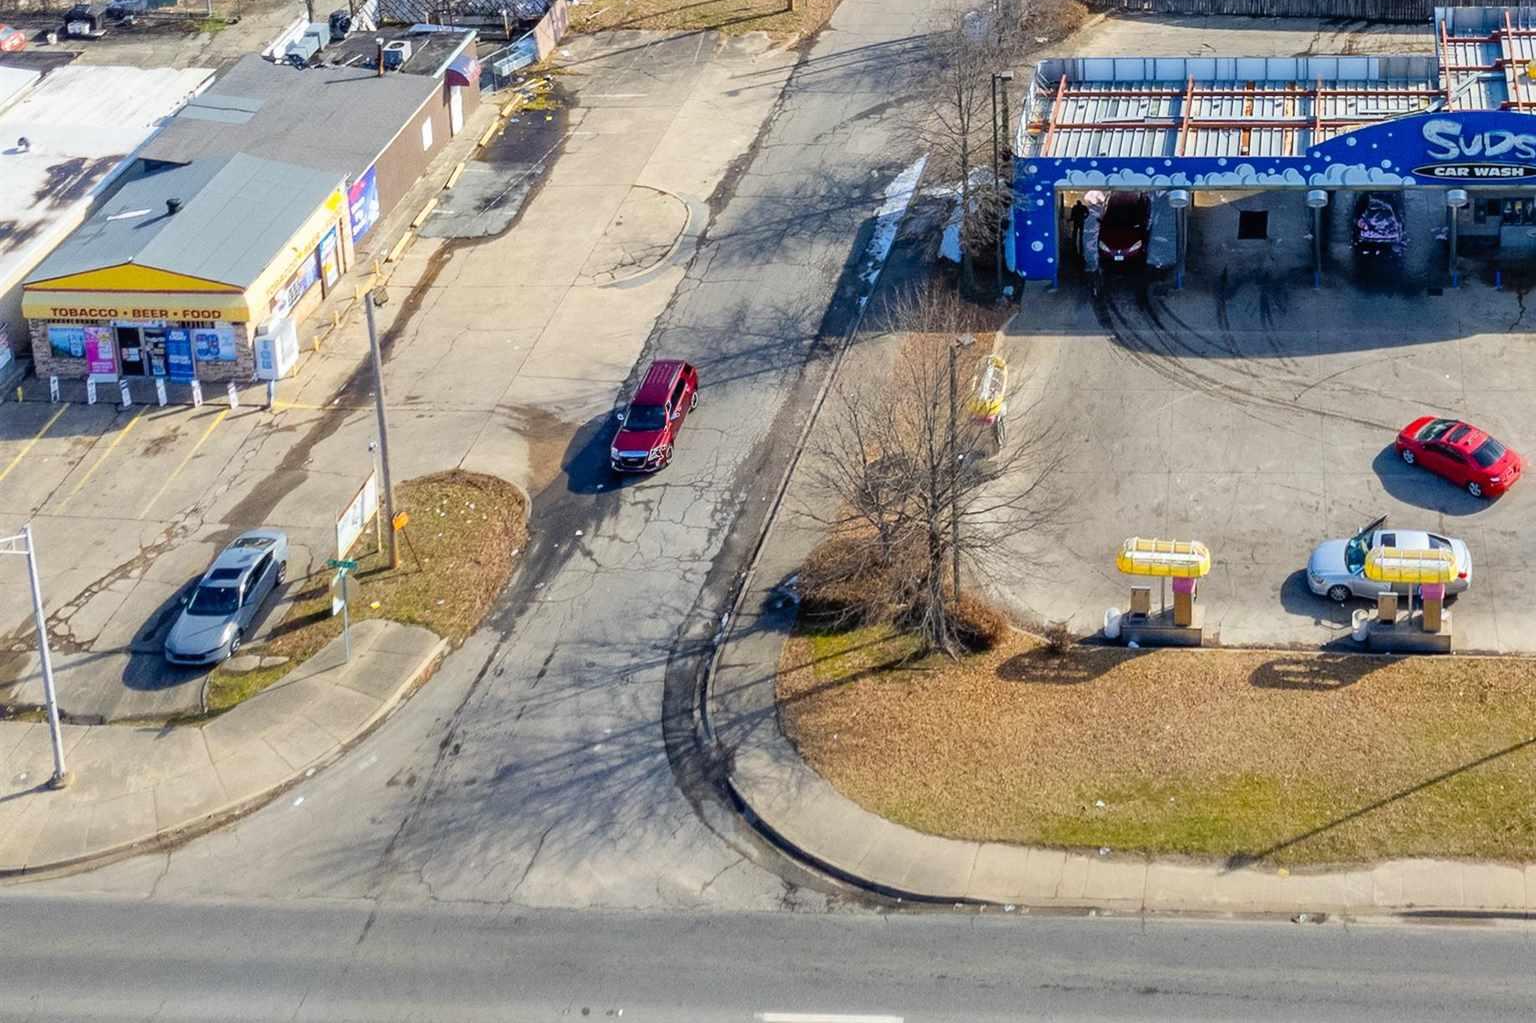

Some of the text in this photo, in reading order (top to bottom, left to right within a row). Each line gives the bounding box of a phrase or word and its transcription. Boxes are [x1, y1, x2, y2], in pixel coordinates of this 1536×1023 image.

[1433, 167, 1525, 177] CAR WASH
[51, 307, 222, 320] TOBACCO BEER FOOD
